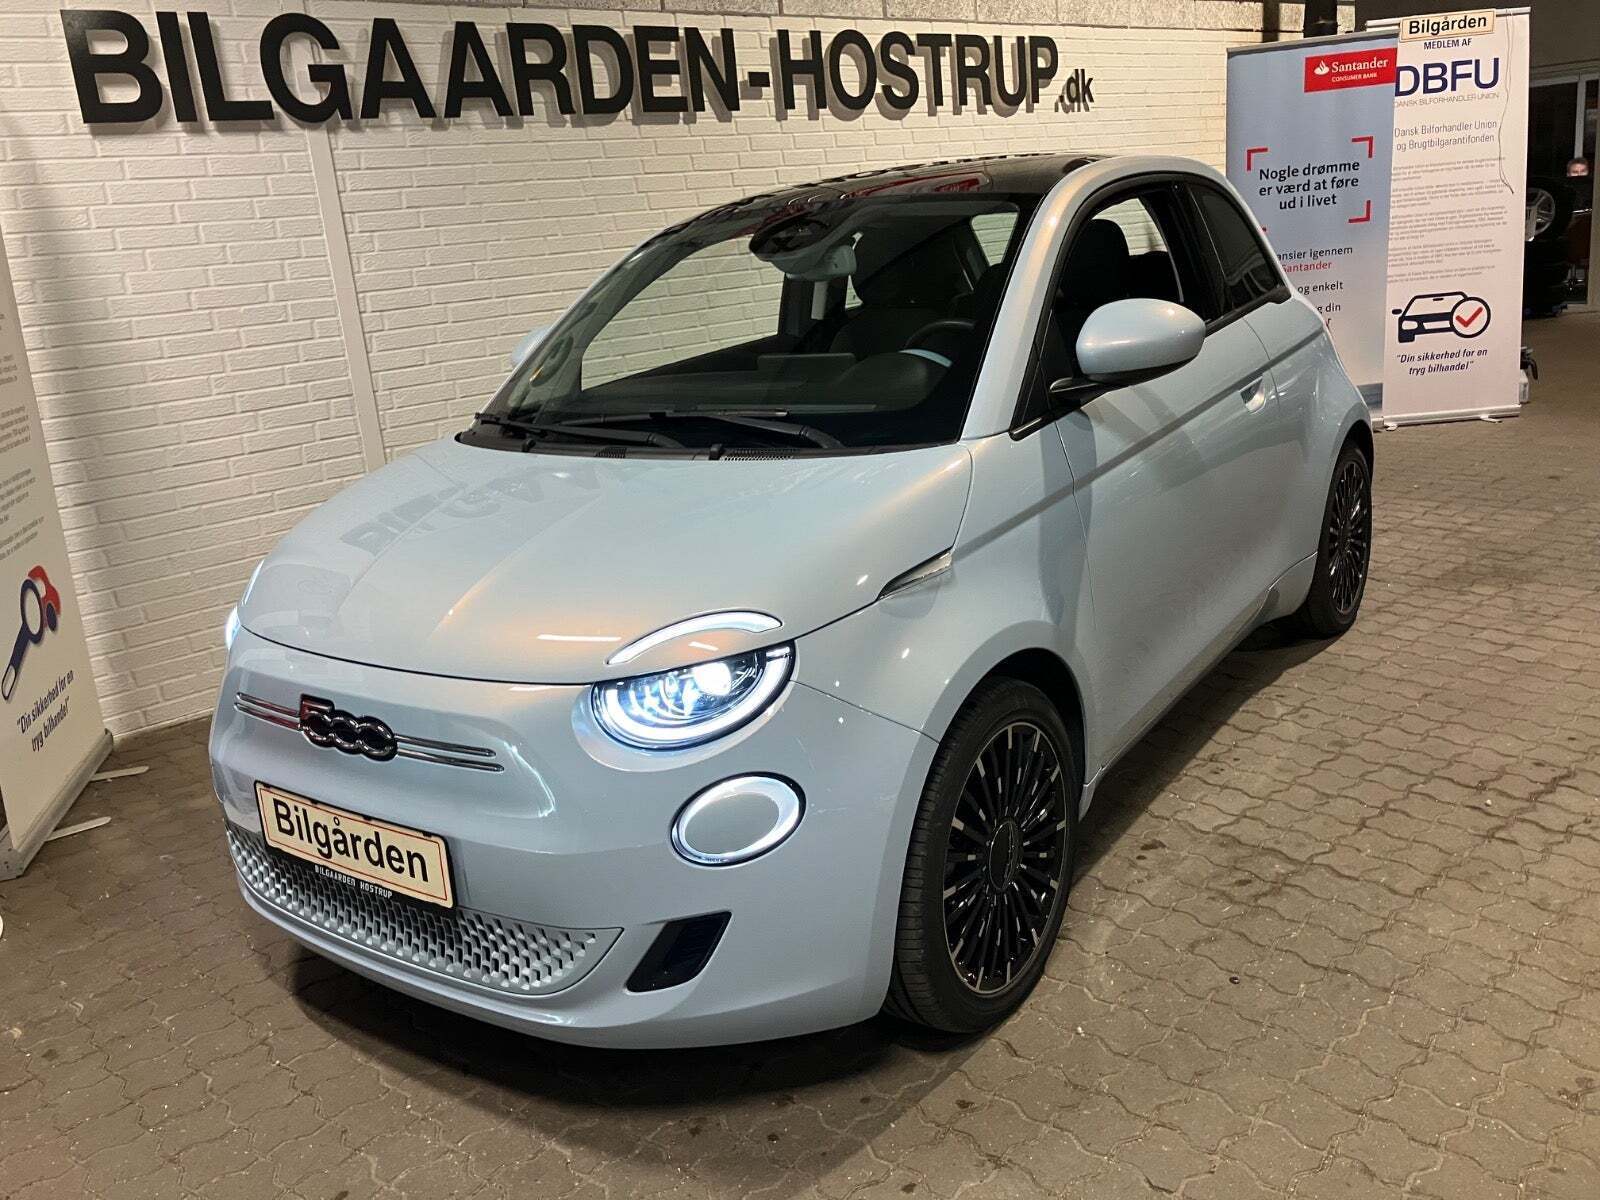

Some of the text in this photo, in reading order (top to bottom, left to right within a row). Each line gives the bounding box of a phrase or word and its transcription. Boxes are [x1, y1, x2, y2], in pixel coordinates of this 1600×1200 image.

[1409, 15, 1487, 35] Bilgården
[1423, 37, 1472, 50] MEDLEM AF
[1331, 56, 1389, 73] Santander
[1331, 72, 1378, 83] CONSUMER BANK
[1395, 57, 1500, 97] DBFU
[1419, 92, 1476, 106] BILFORHANDLER
[1477, 91, 1499, 100] UNION
[1394, 119, 1497, 138] Dansk Bilforhandler Union
[1396, 133, 1495, 152] og Brugtbilgarantifonden
[1259, 161, 1360, 182] Nogle drømme
[1259, 176, 1359, 196] er værd at føre
[1279, 193, 1337, 210] ud i livet
[1276, 246, 1353, 260] ansier igennem
[1281, 261, 1333, 273] Santander
[1297, 280, 1344, 295] og enkelt
[1325, 302, 1341, 313] din
[1417, 349, 1460, 362] sikkerhed
[1462, 348, 1475, 358] for
[1408, 366, 1426, 376] tryg
[31, 681, 60, 722] sikkerhed
[58, 676, 67, 693] for
[31, 731, 44, 752] tryg
[272, 798, 429, 883] Bilgården
[314, 864, 393, 900] BILGAARDEN HOSTRUP
